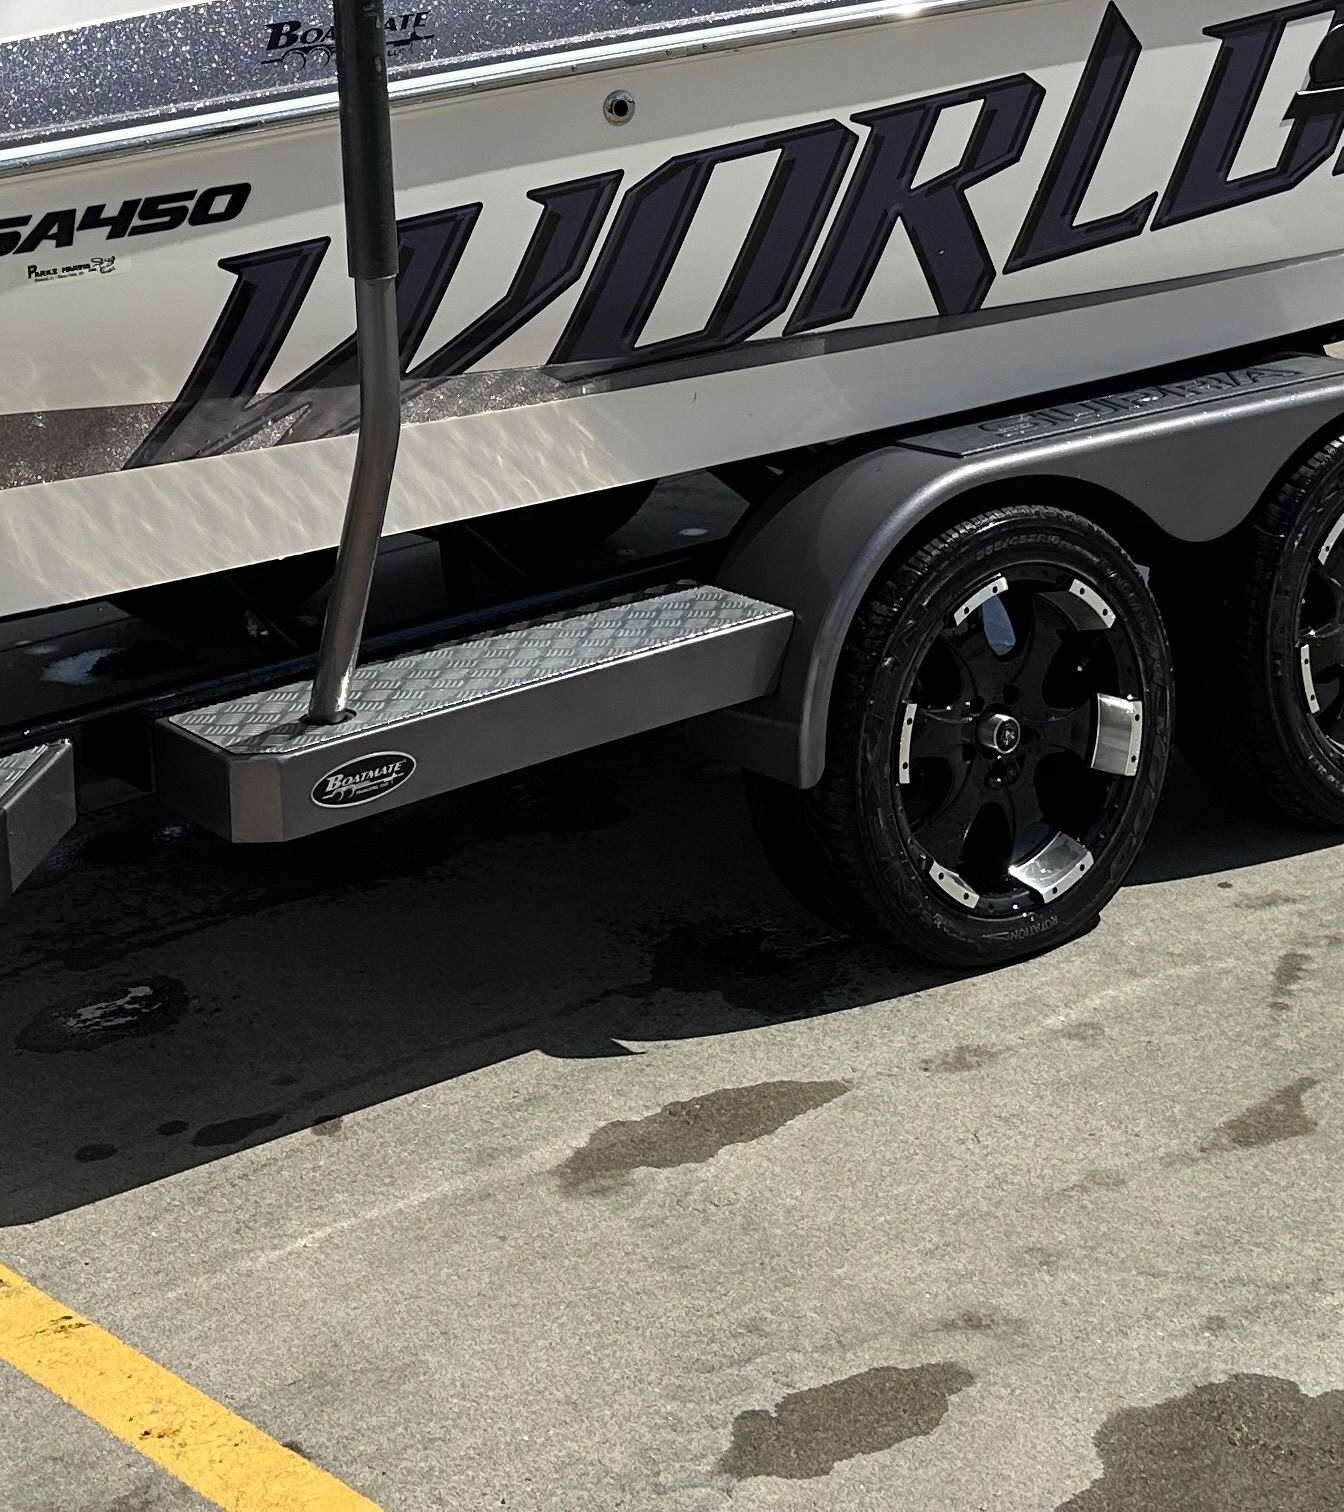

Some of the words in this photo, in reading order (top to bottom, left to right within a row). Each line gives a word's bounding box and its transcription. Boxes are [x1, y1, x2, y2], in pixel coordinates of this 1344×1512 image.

[263, 11, 432, 52] BOAATE
[978, 365, 1303, 437] SUPRA
[325, 760, 403, 792] BOATMATE
[1009, 915, 1058, 941] ROTATION
